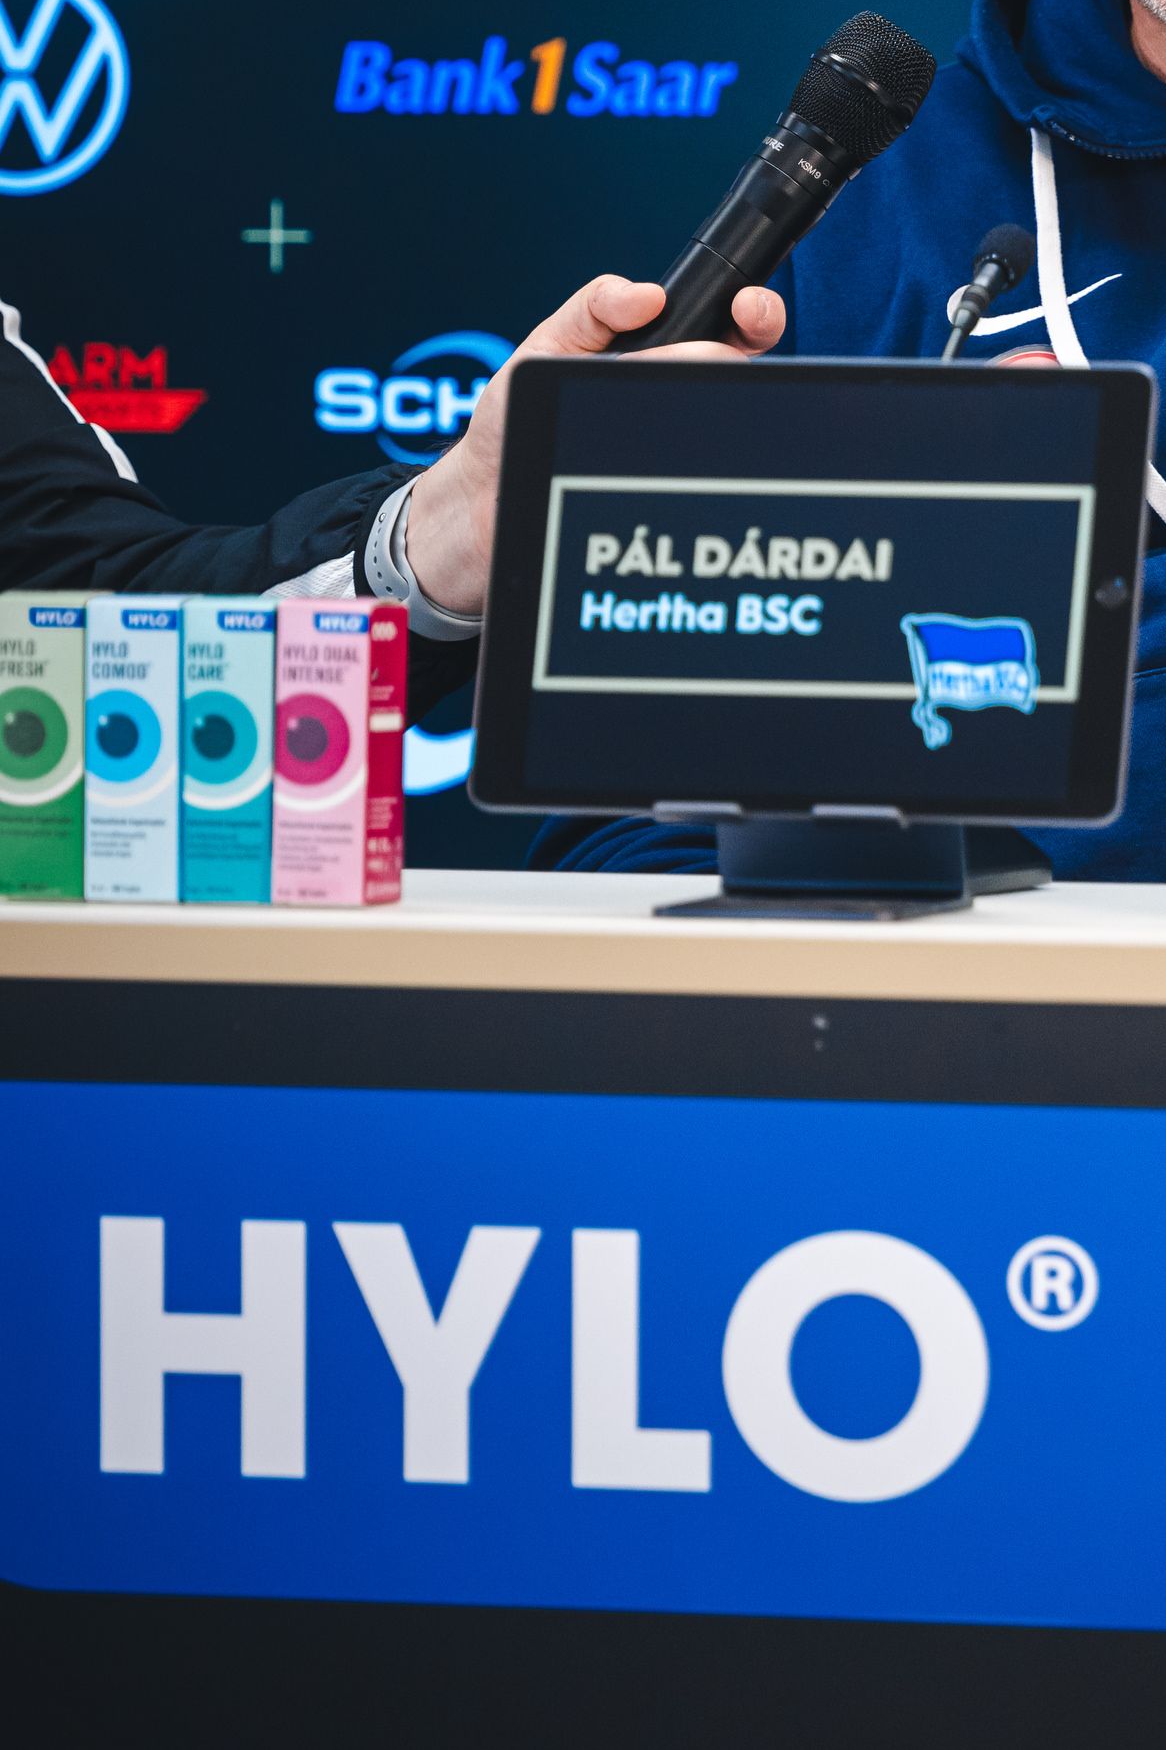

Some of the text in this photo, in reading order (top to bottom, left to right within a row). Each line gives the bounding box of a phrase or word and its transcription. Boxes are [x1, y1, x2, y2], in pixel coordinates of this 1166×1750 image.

[797, 157, 822, 180] KSM9
[586, 524, 893, 582] PÁL DÁRDAI
[580, 591, 824, 637] Hertha BSC
[91, 641, 129, 659] HYLO
[187, 643, 225, 660] HYLO
[187, 663, 225, 681] CARE
